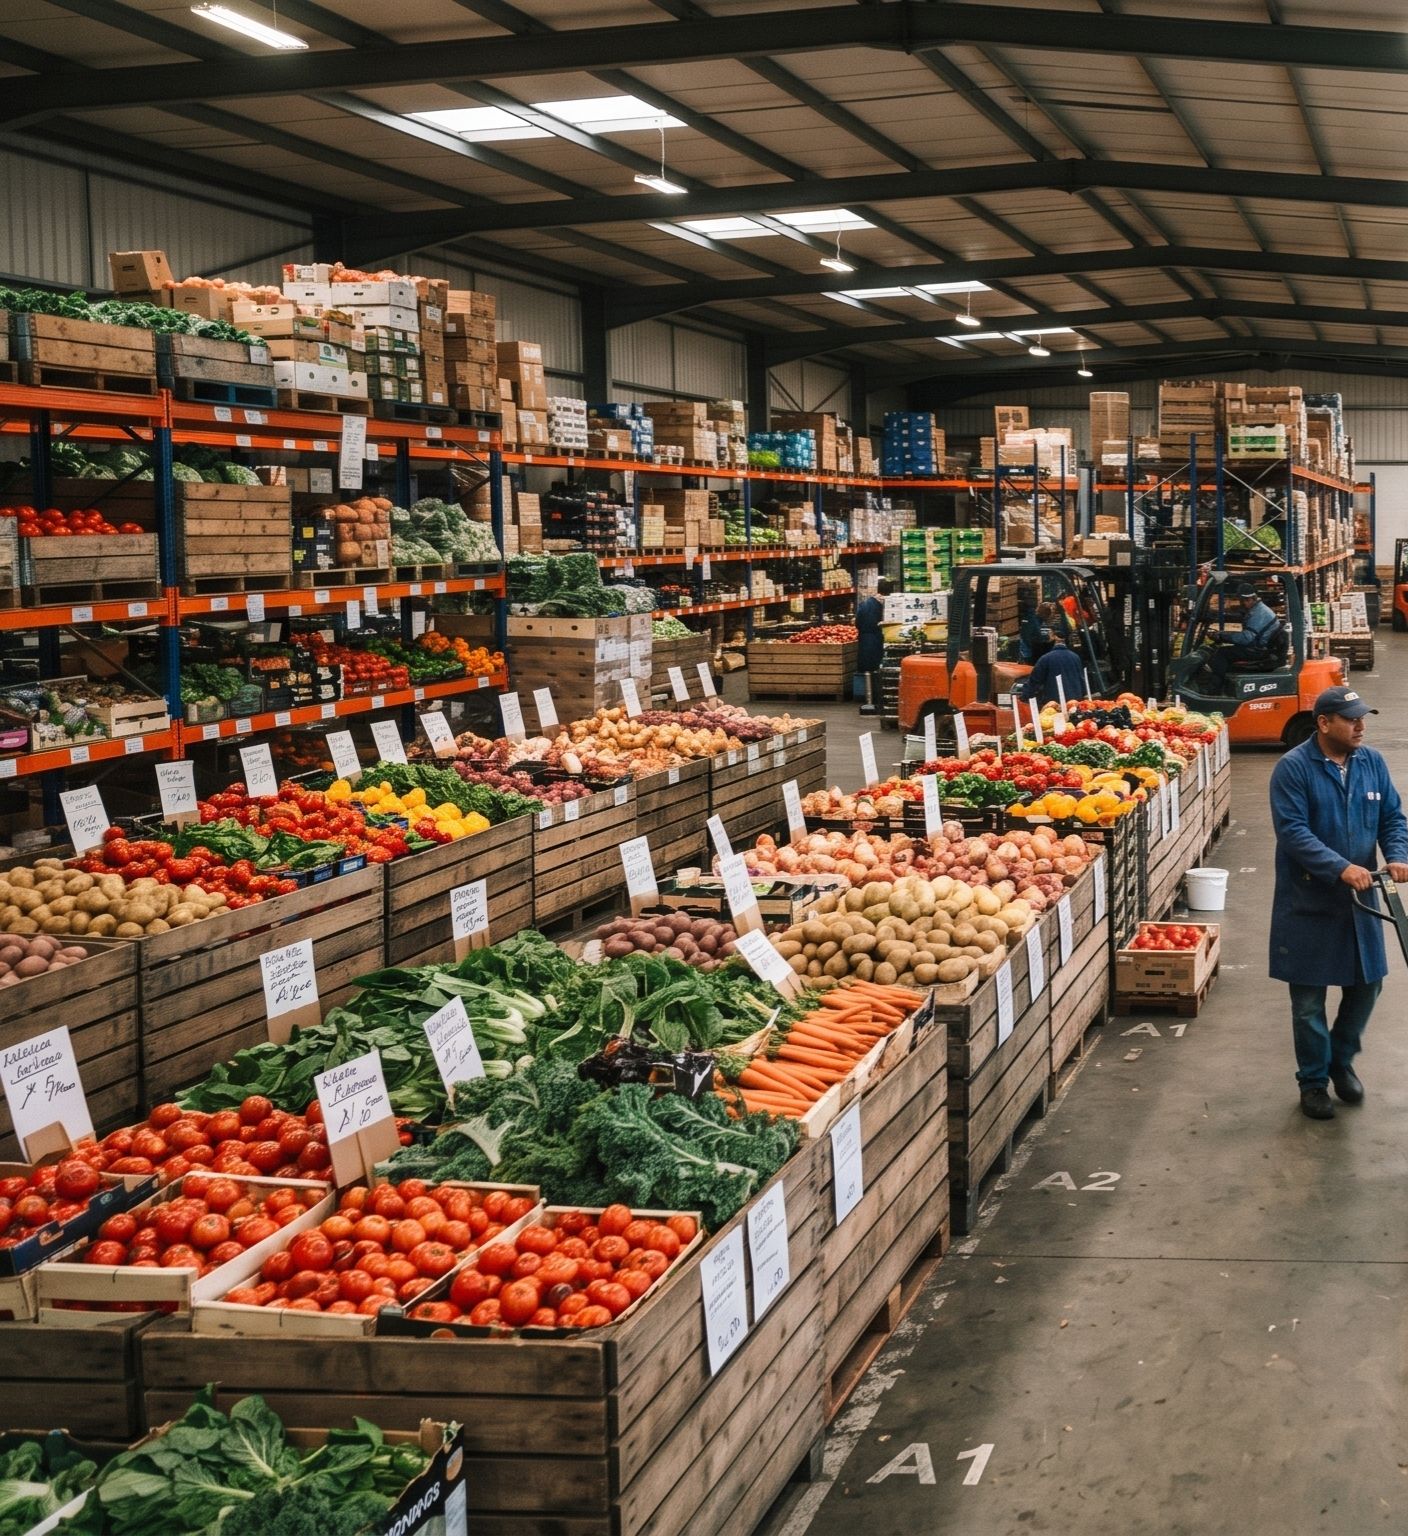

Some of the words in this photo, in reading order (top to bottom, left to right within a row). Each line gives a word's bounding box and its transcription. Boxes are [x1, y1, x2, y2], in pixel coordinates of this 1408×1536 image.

[1120, 1022, 1187, 1037] A1
[1031, 1171, 1121, 1191] A2
[865, 1442, 995, 1486] A1
